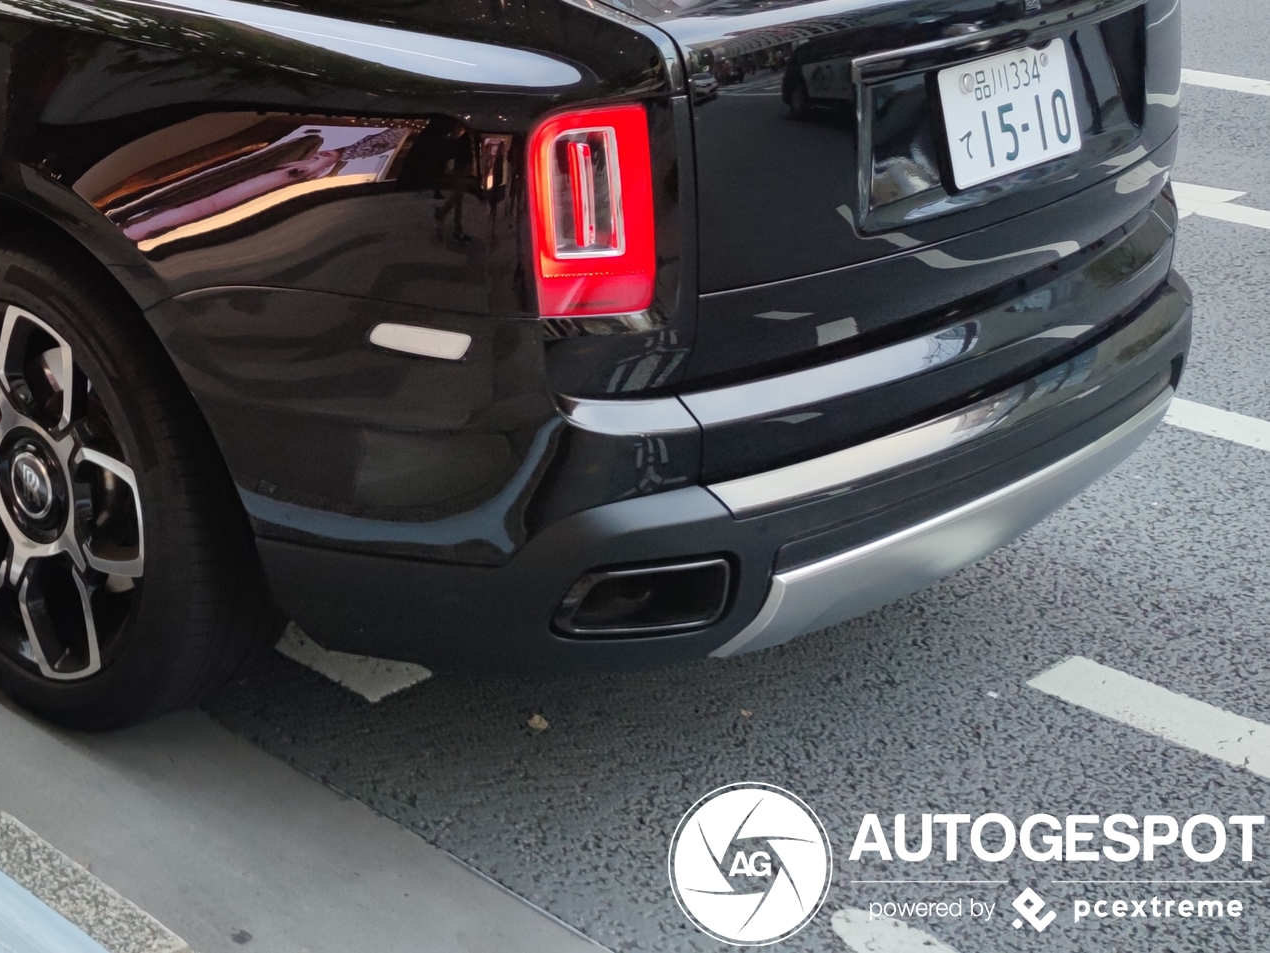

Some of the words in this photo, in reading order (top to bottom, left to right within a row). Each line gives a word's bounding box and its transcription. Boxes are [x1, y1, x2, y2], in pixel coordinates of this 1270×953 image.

[974, 55, 1040, 101] 品川334
[959, 130, 973, 159] て
[981, 88, 1071, 168] 15-10
